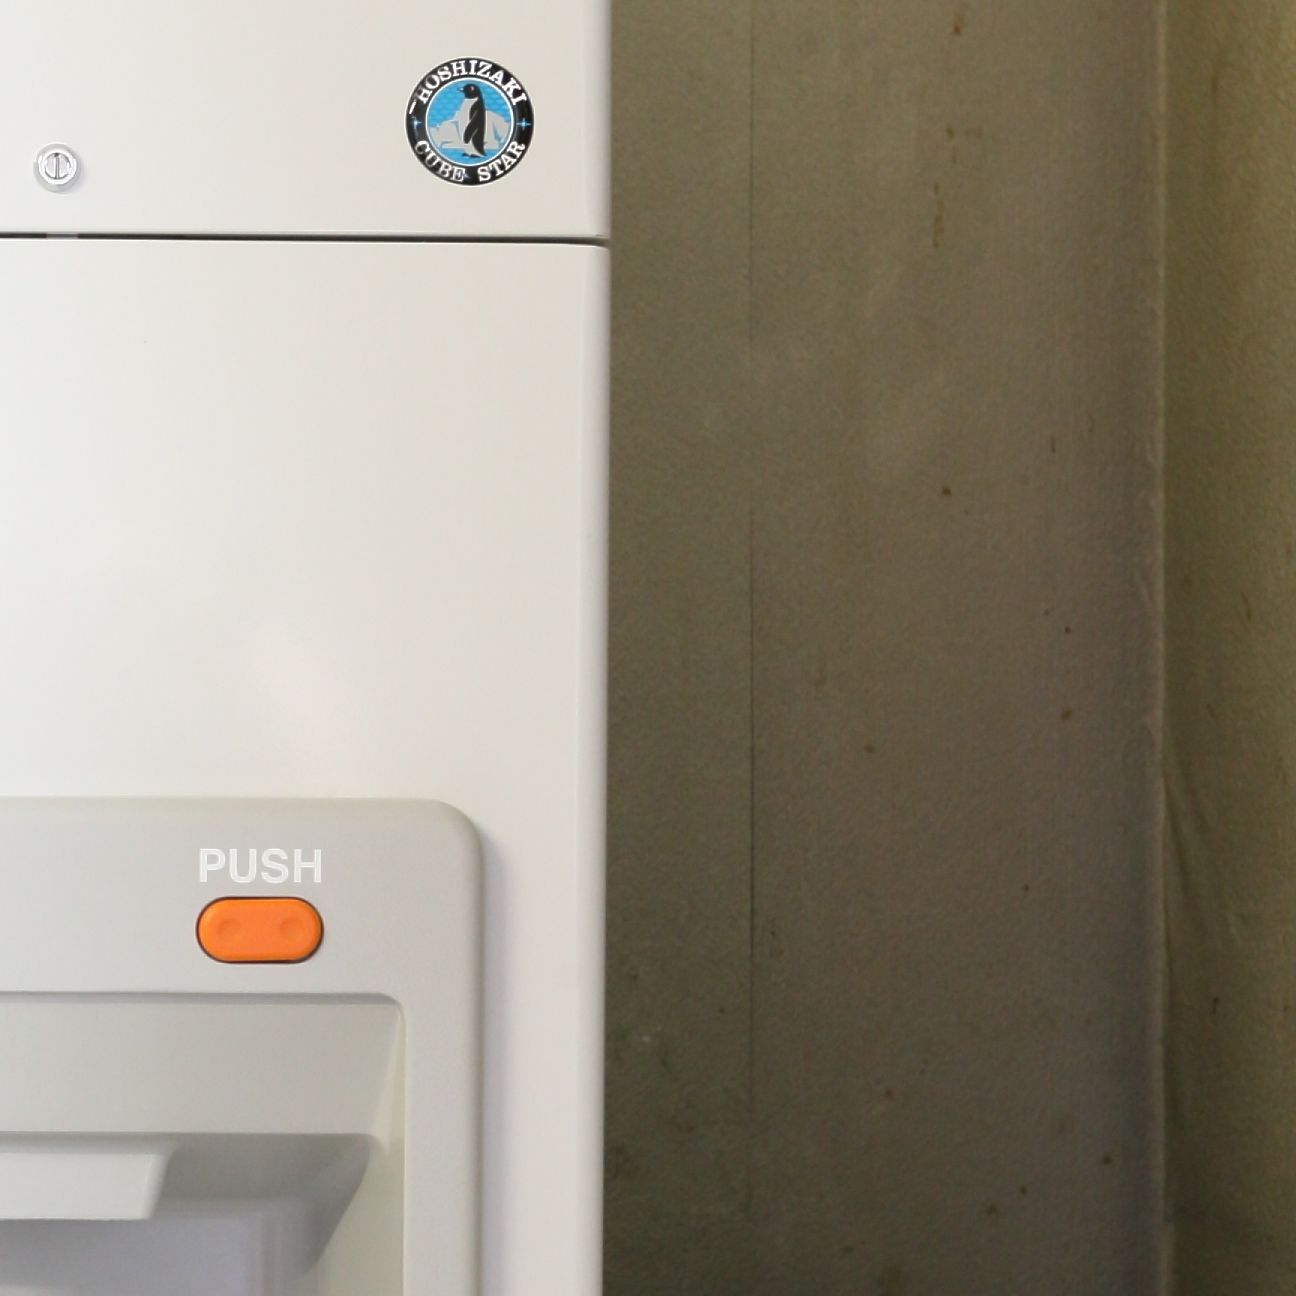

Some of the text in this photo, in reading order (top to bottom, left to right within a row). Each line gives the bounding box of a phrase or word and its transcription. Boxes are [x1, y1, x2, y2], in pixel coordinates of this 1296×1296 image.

[410, 59, 528, 114] HOSHIZAKI
[415, 140, 526, 183] CUBE STAR
[198, 848, 323, 884] PUSH
